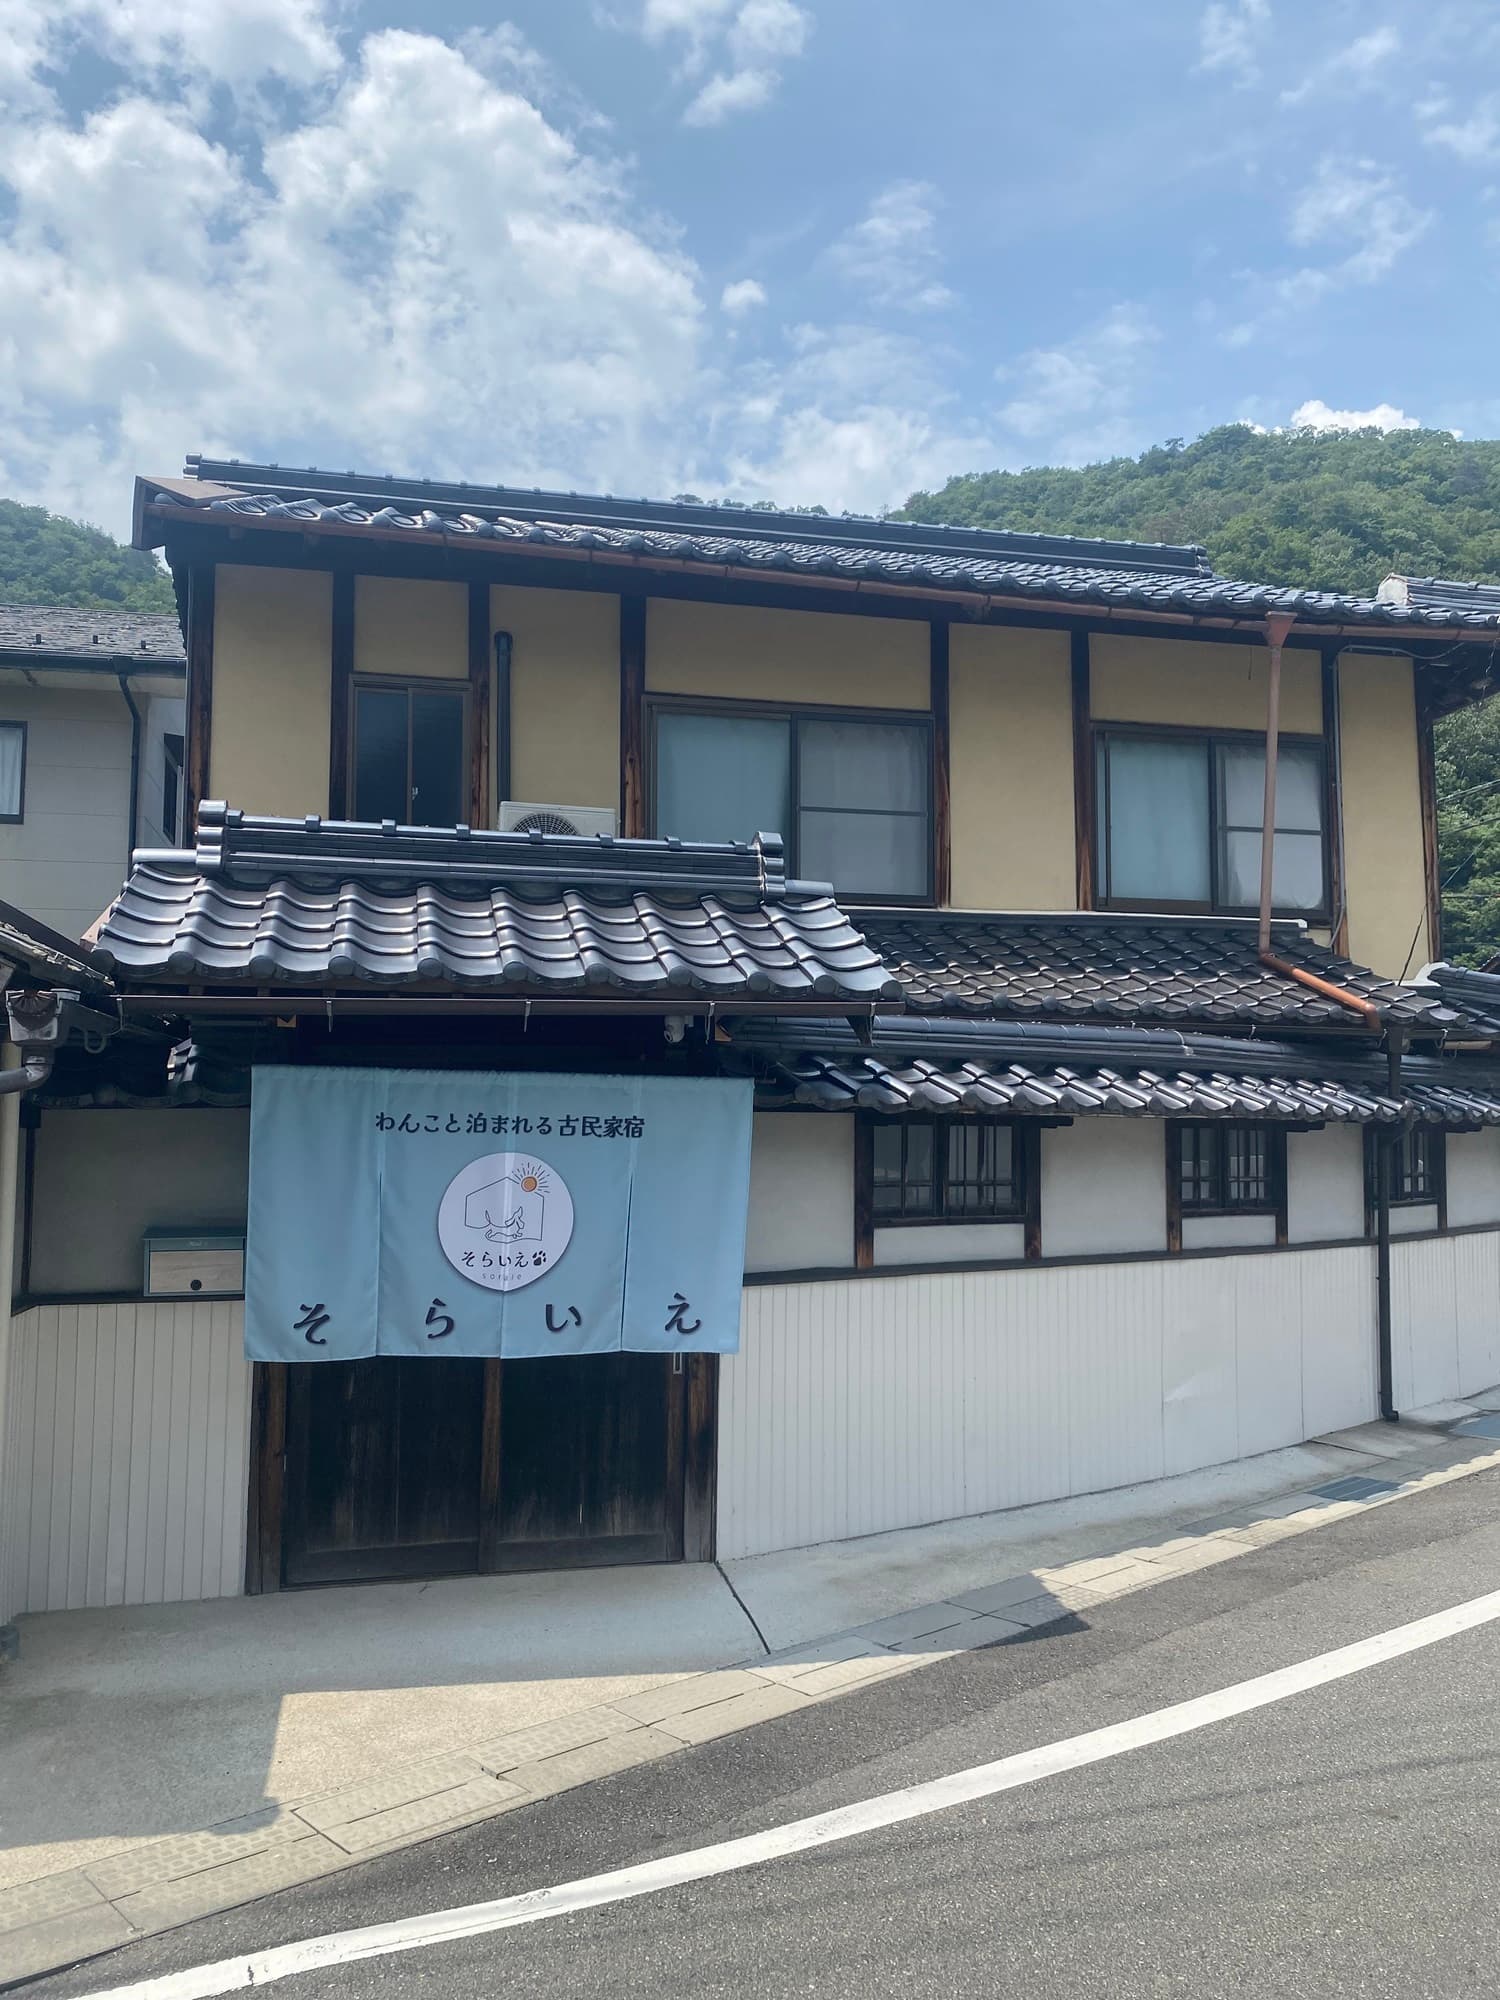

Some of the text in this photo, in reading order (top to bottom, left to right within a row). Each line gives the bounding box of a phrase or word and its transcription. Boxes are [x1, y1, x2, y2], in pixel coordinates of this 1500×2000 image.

[374, 1111, 646, 1139] わんこと泊まれる古民家宿
[460, 1251, 528, 1268] そらいえ
[292, 1292, 702, 1346] そらいえ
